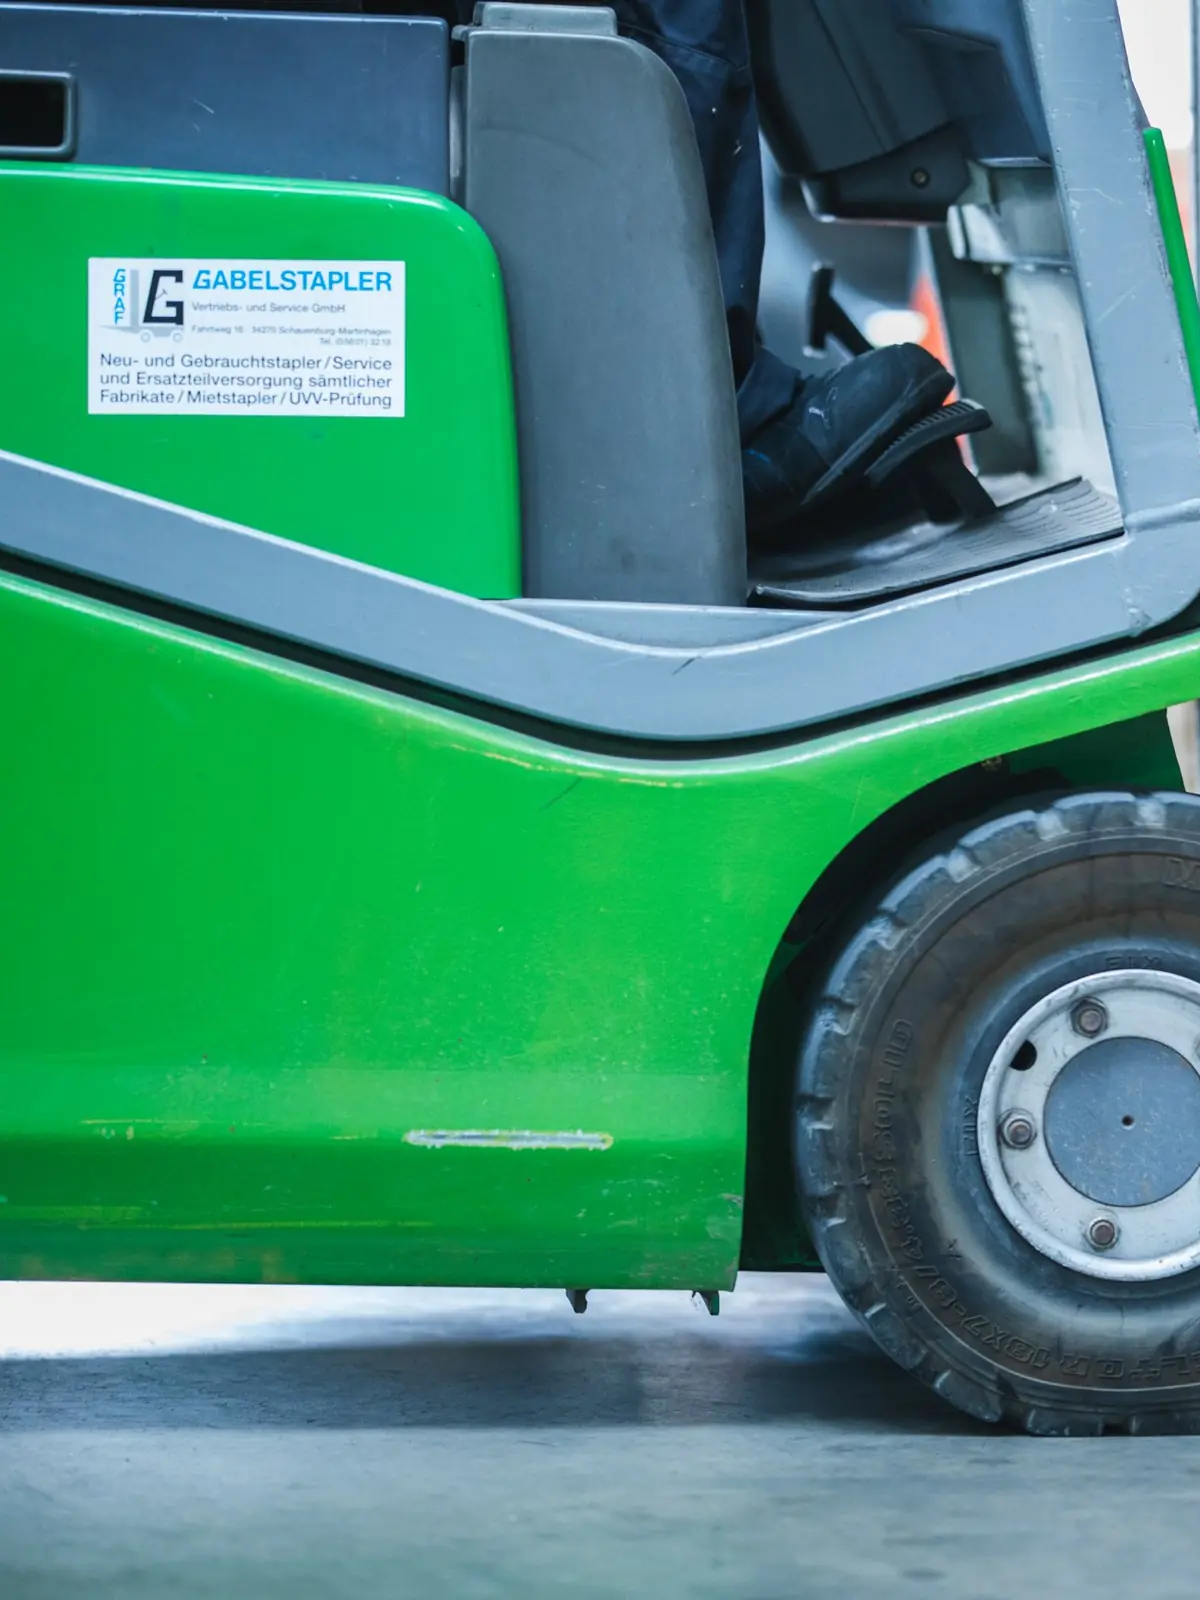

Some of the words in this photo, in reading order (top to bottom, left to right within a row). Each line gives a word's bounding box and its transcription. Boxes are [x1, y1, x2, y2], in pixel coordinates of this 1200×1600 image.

[192, 269, 392, 292] GABELSTAPLER
[112, 268, 126, 325] GRAF
[191, 302, 243, 312] Vertriebs-
[246, 303, 267, 313] und
[269, 303, 309, 313] Service
[311, 303, 346, 313] GmbH
[100, 353, 139, 367] Neu-
[144, 354, 175, 368] und
[100, 372, 130, 385] und
[136, 371, 303, 390] Ersatzteilversorgung
[308, 374, 392, 388] sämtlicher
